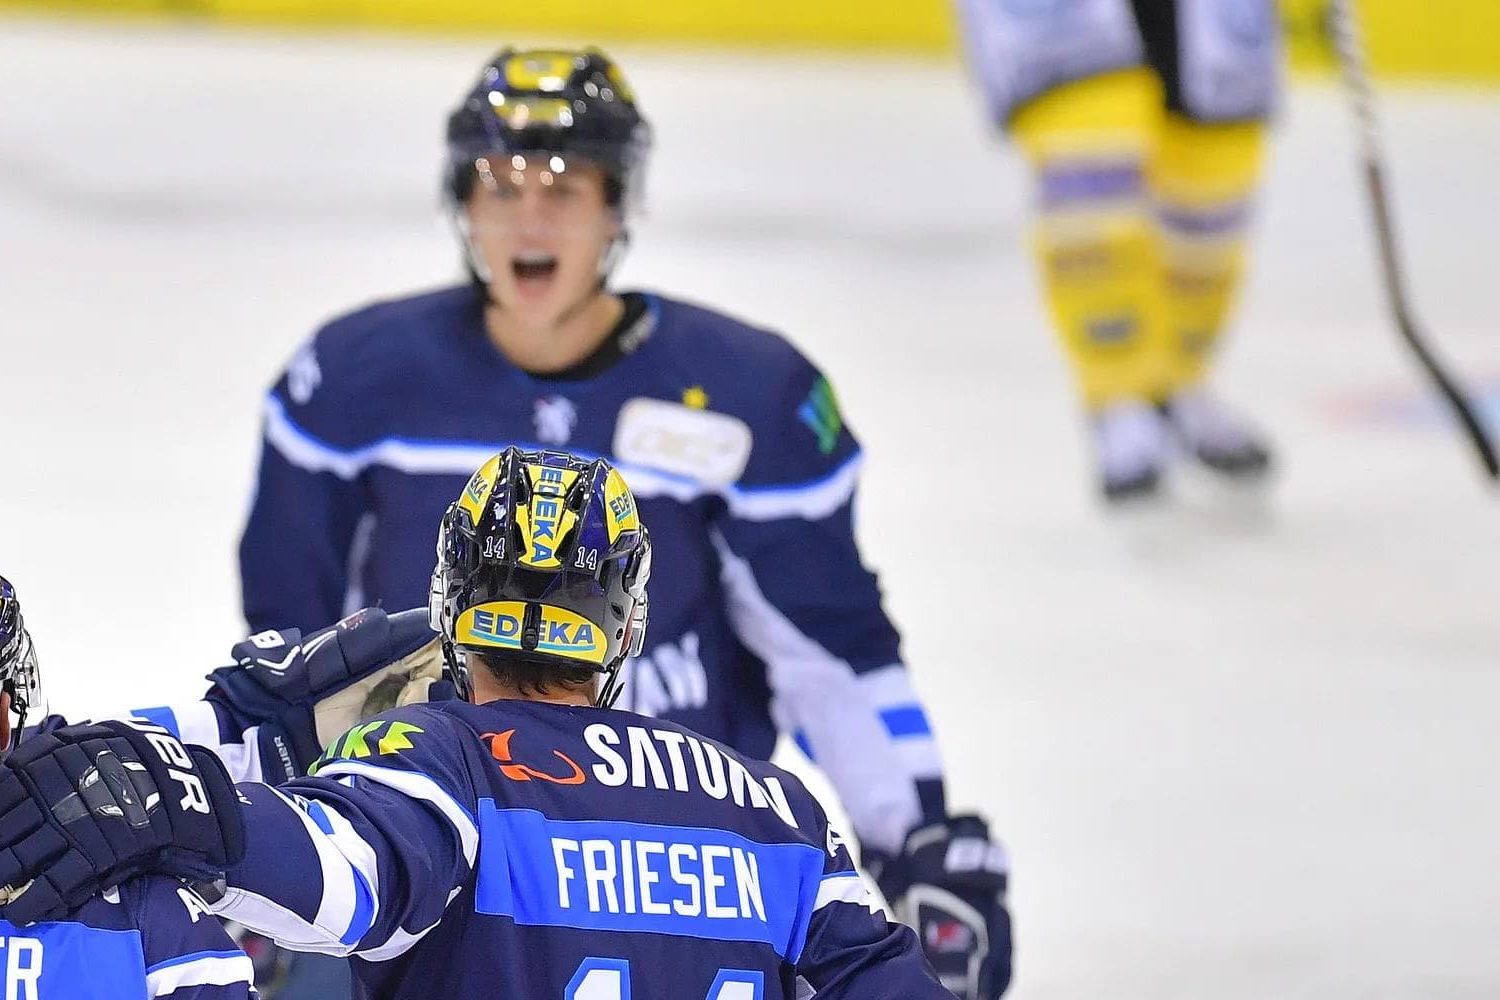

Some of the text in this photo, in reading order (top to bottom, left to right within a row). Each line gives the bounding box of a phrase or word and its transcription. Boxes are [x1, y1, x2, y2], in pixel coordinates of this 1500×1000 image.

[531, 467, 563, 563] EDEKA
[483, 535, 506, 560] 14
[574, 545, 599, 571] 14
[551, 836, 768, 923] FRIESEN
